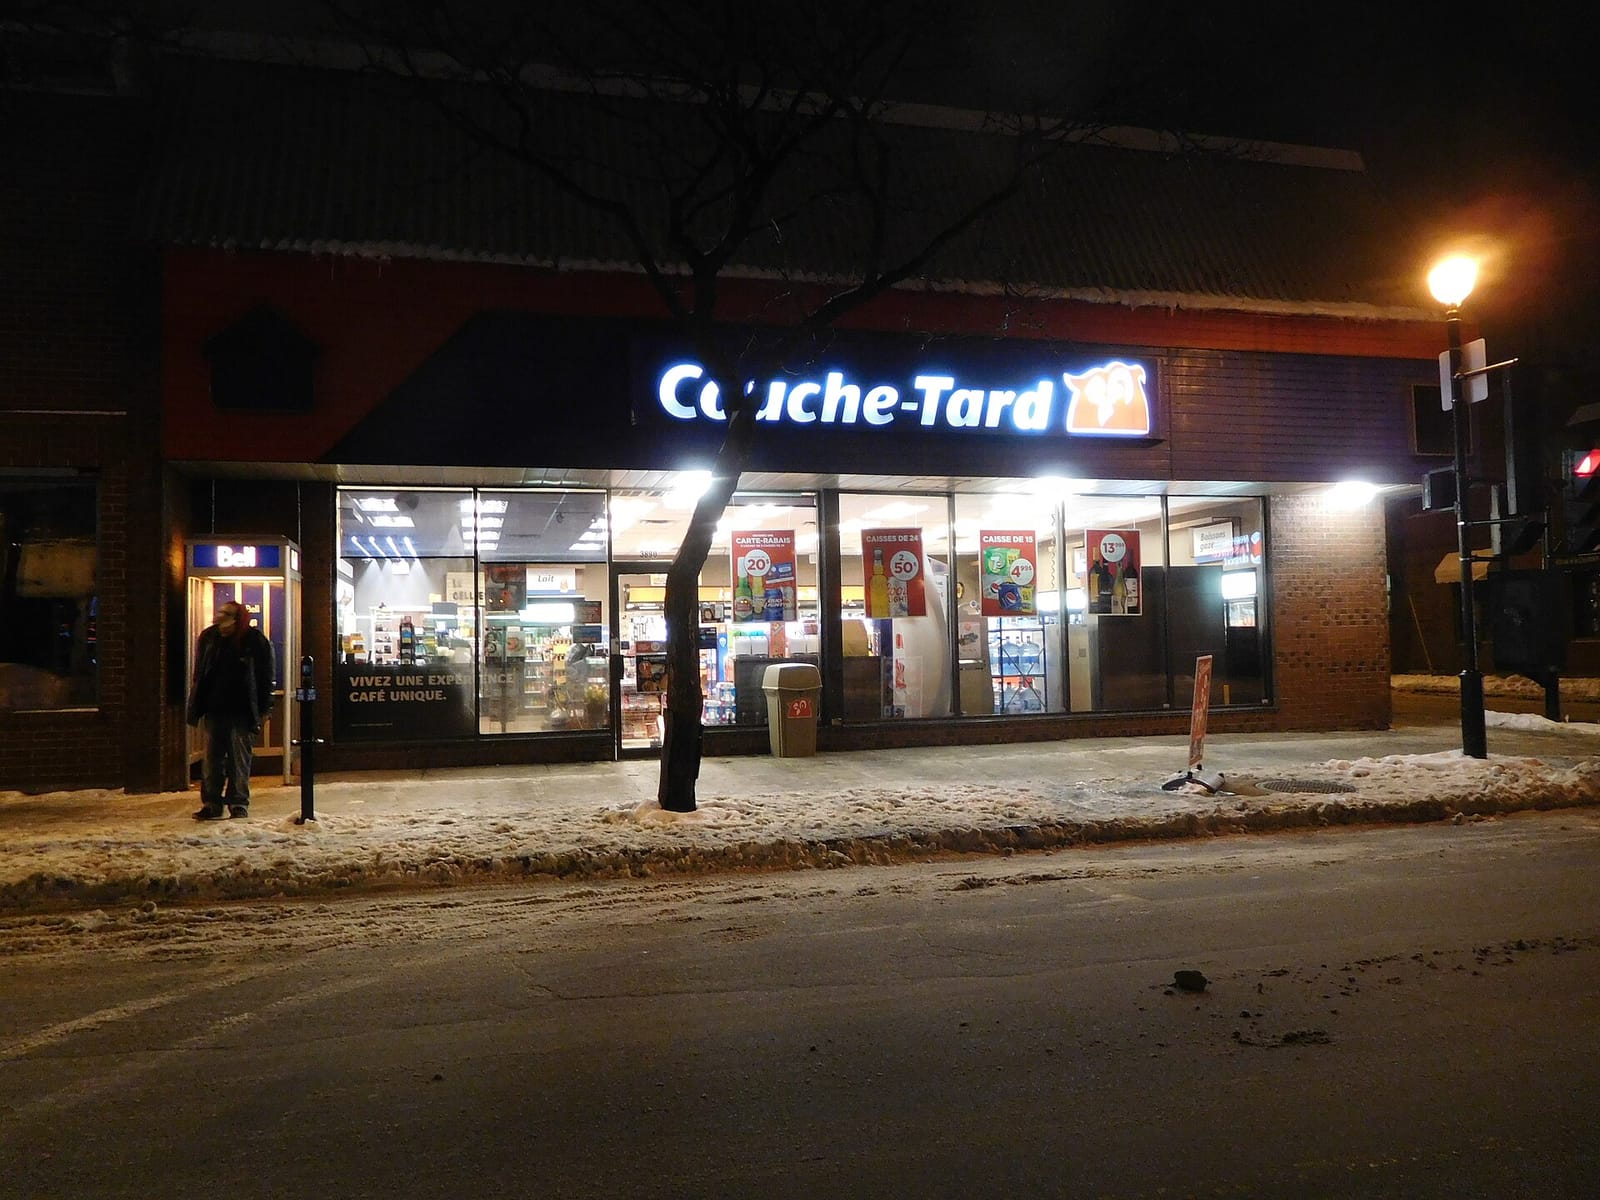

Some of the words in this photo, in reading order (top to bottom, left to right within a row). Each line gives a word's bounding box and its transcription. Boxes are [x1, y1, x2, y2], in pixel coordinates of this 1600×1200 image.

[866, 535, 897, 543] CAISSES
[983, 535, 1012, 543] CAISSE
[1012, 535, 1024, 543] DE
[217, 545, 256, 567] Bell
[537, 575, 555, 583] Lait
[349, 676, 391, 687] VIVEZ
[395, 675, 424, 686] UNE
[428, 672, 514, 685] EXPÉRENCE
[349, 689, 385, 702] CAFÉ
[390, 690, 447, 702] UNIQUE.
